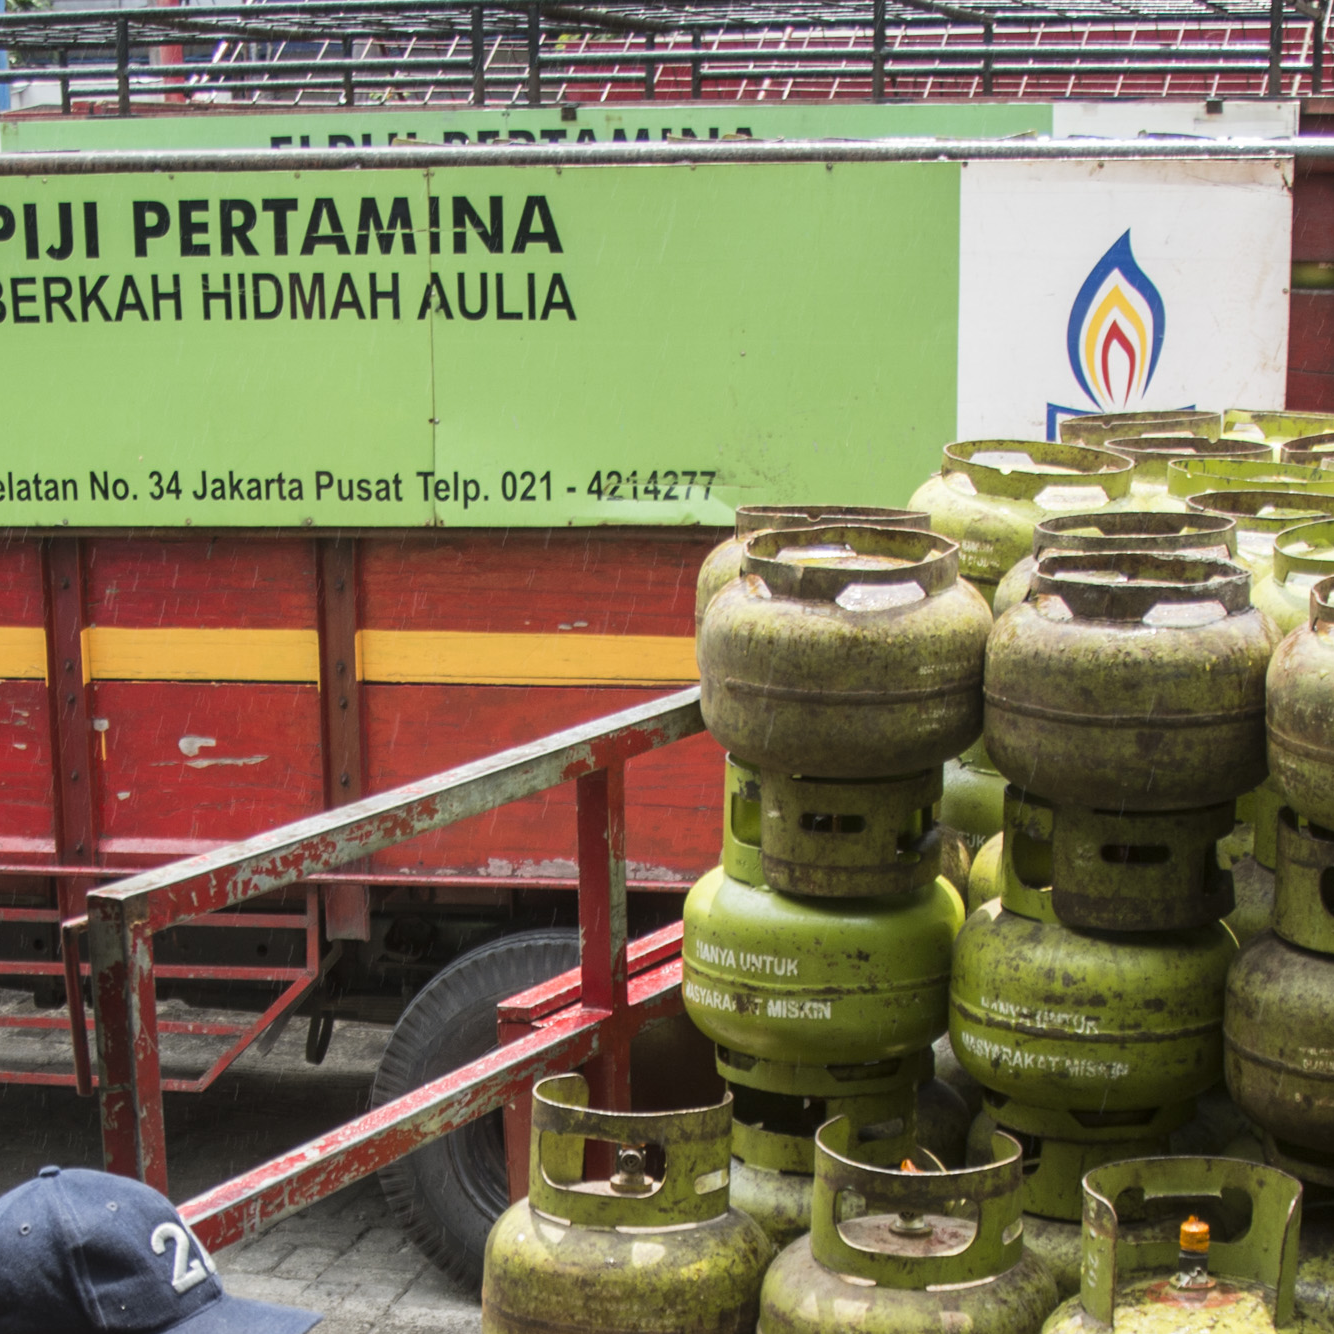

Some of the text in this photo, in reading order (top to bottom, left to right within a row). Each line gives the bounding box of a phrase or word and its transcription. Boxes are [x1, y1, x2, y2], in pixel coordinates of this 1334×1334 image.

[132, 195, 564, 258] PERTAMINA
[201, 273, 400, 321] HIDMAH
[417, 272, 577, 321] AULIA
[89, 471, 138, 501] No.
[148, 471, 183, 500] 34
[192, 470, 303, 501] Jakarta
[314, 471, 403, 501] Pusat
[415, 471, 489, 509] Telp.
[501, 470, 553, 501] 021
[586, 470, 717, 502] 4214277
[696, 940, 799, 977] HANYA UNTUK
[767, 998, 832, 1020] MISKIN
